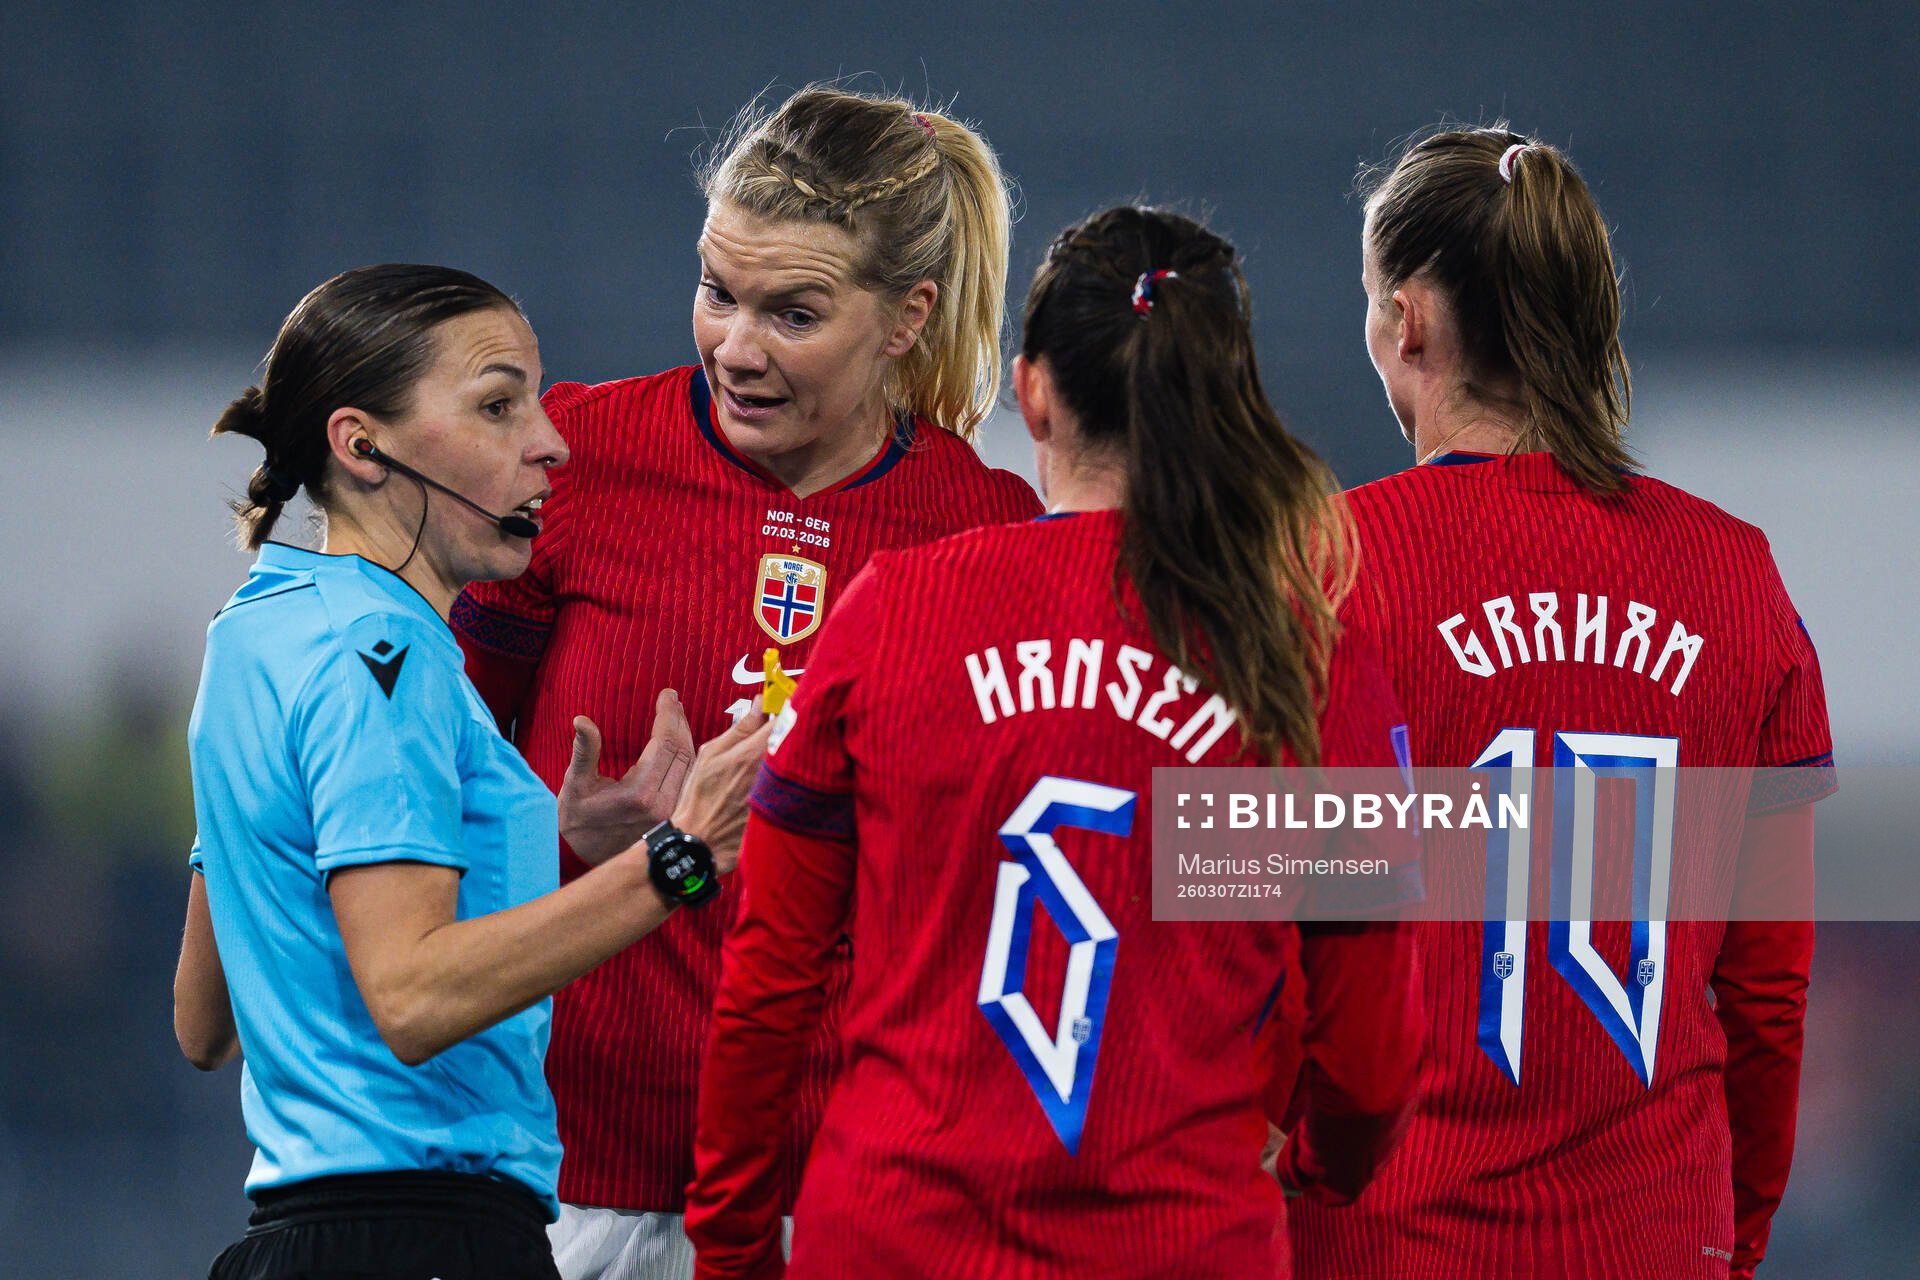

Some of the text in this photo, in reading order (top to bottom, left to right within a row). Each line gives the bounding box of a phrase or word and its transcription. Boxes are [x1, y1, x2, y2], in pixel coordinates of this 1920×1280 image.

[762, 525, 831, 549] 07.03.2026
[767, 510, 794, 524] NOR
[805, 517, 830, 532] GER
[783, 560, 803, 572] NORGE
[1437, 592, 1704, 696] GRAHAM
[964, 638, 1238, 764] HANSEN
[1469, 728, 1680, 1091] 10
[977, 775, 1138, 1158] 6
